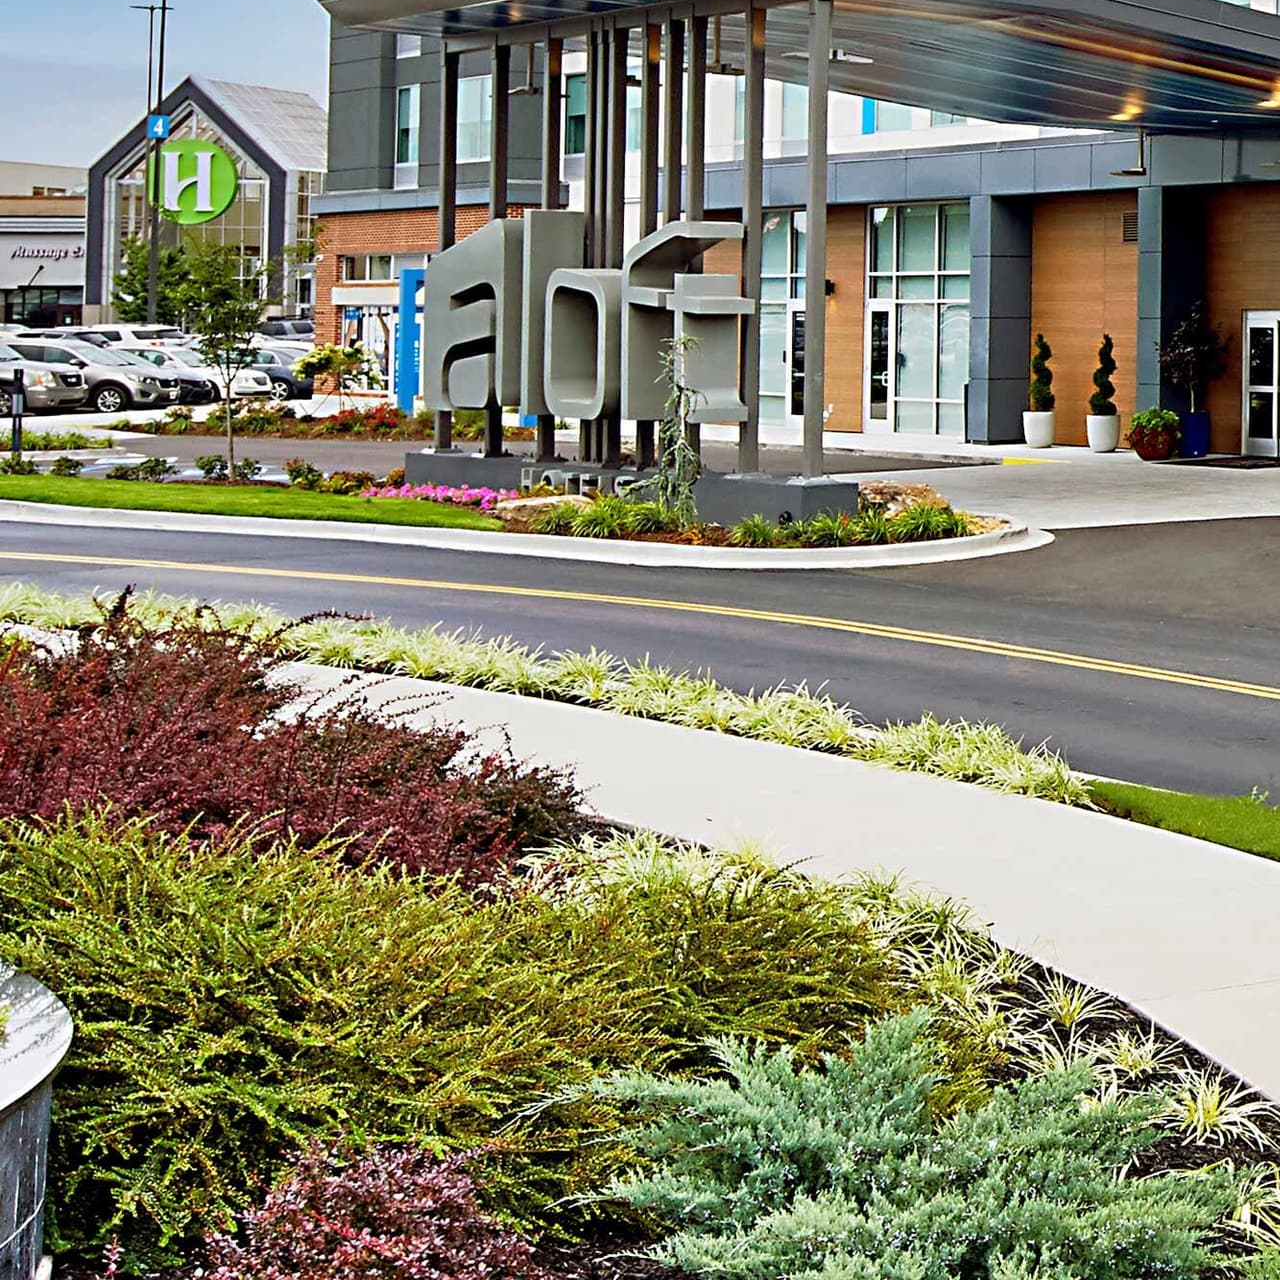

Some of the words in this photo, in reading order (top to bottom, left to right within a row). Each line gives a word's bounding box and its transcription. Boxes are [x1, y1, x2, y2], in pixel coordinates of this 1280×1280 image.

[153, 118, 164, 135] 4
[161, 151, 216, 212] H
[11, 245, 68, 261] Massage
[424, 208, 756, 424] aloft
